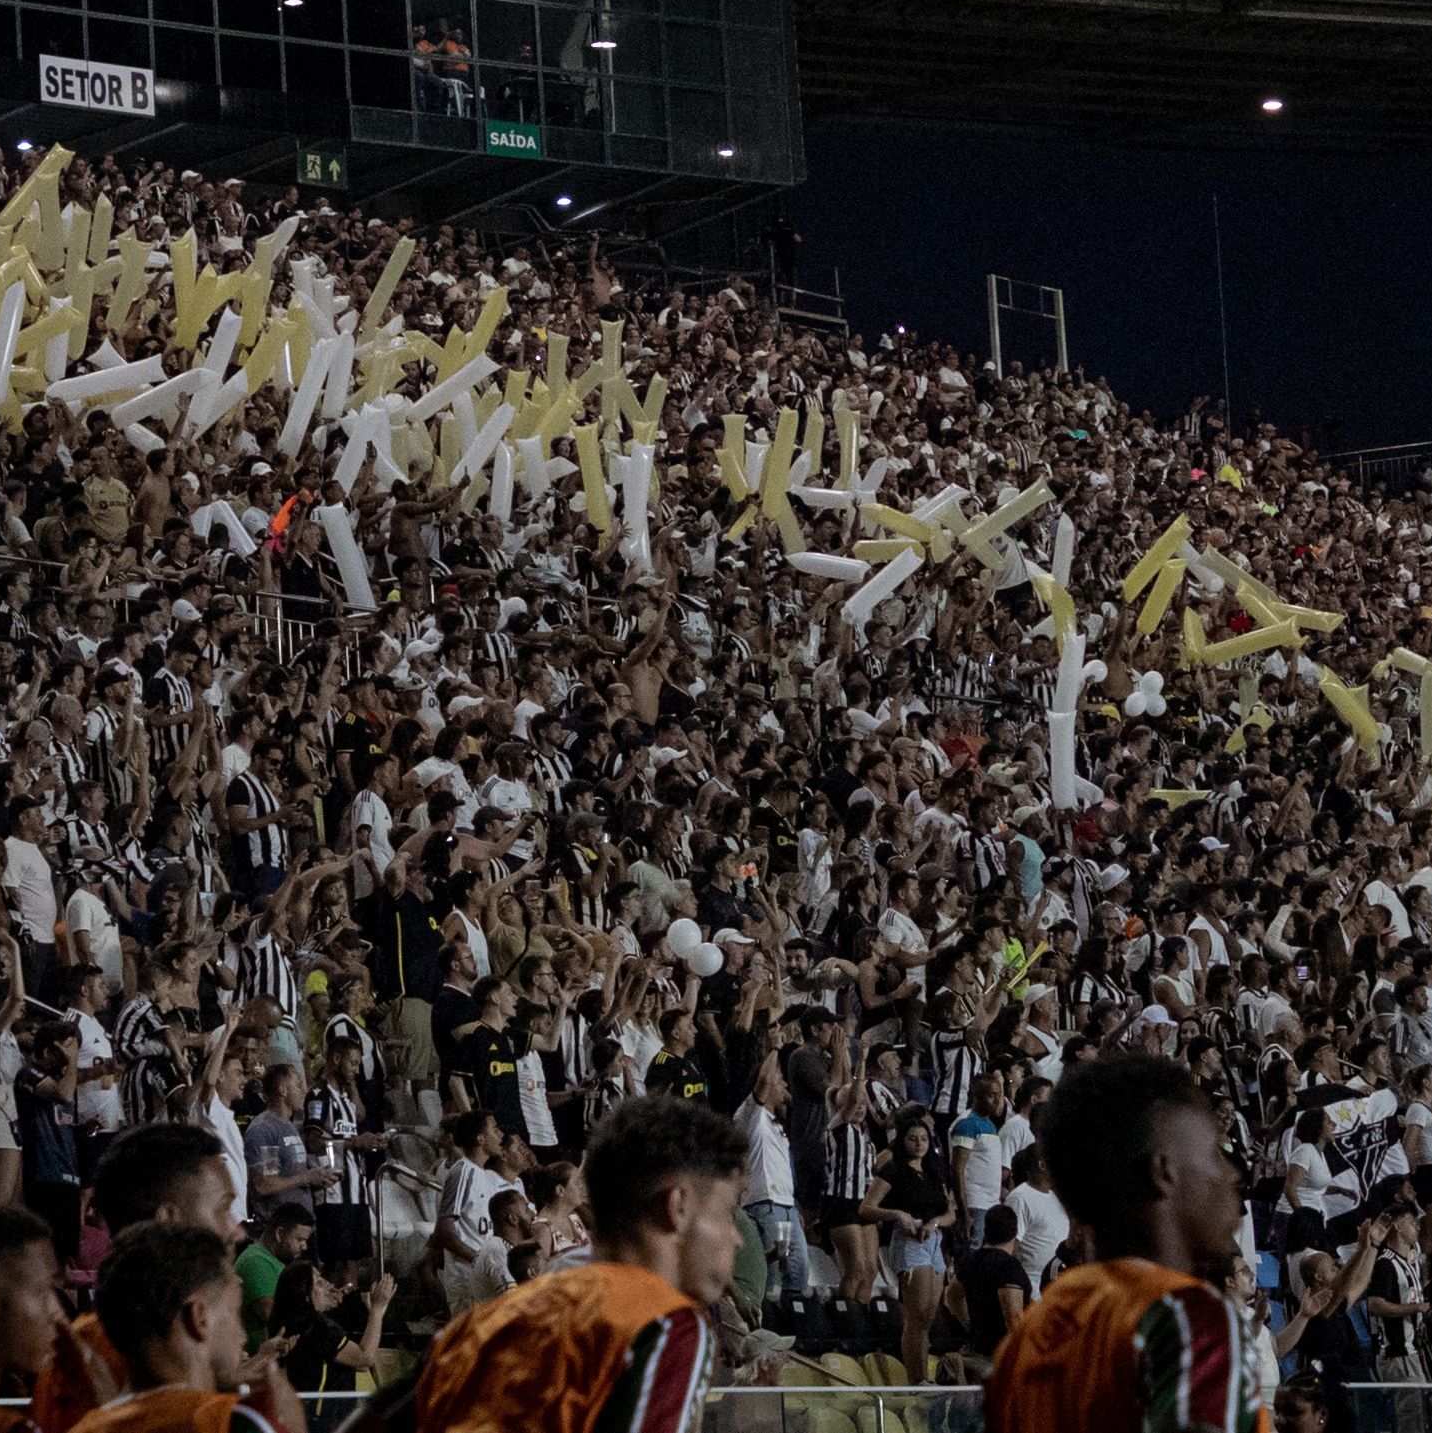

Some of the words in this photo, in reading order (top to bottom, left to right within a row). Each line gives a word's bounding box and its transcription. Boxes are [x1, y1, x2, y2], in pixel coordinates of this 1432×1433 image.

[45, 65, 123, 107] SETOR
[131, 71, 149, 109] B
[489, 129, 537, 150] SAÍDA
